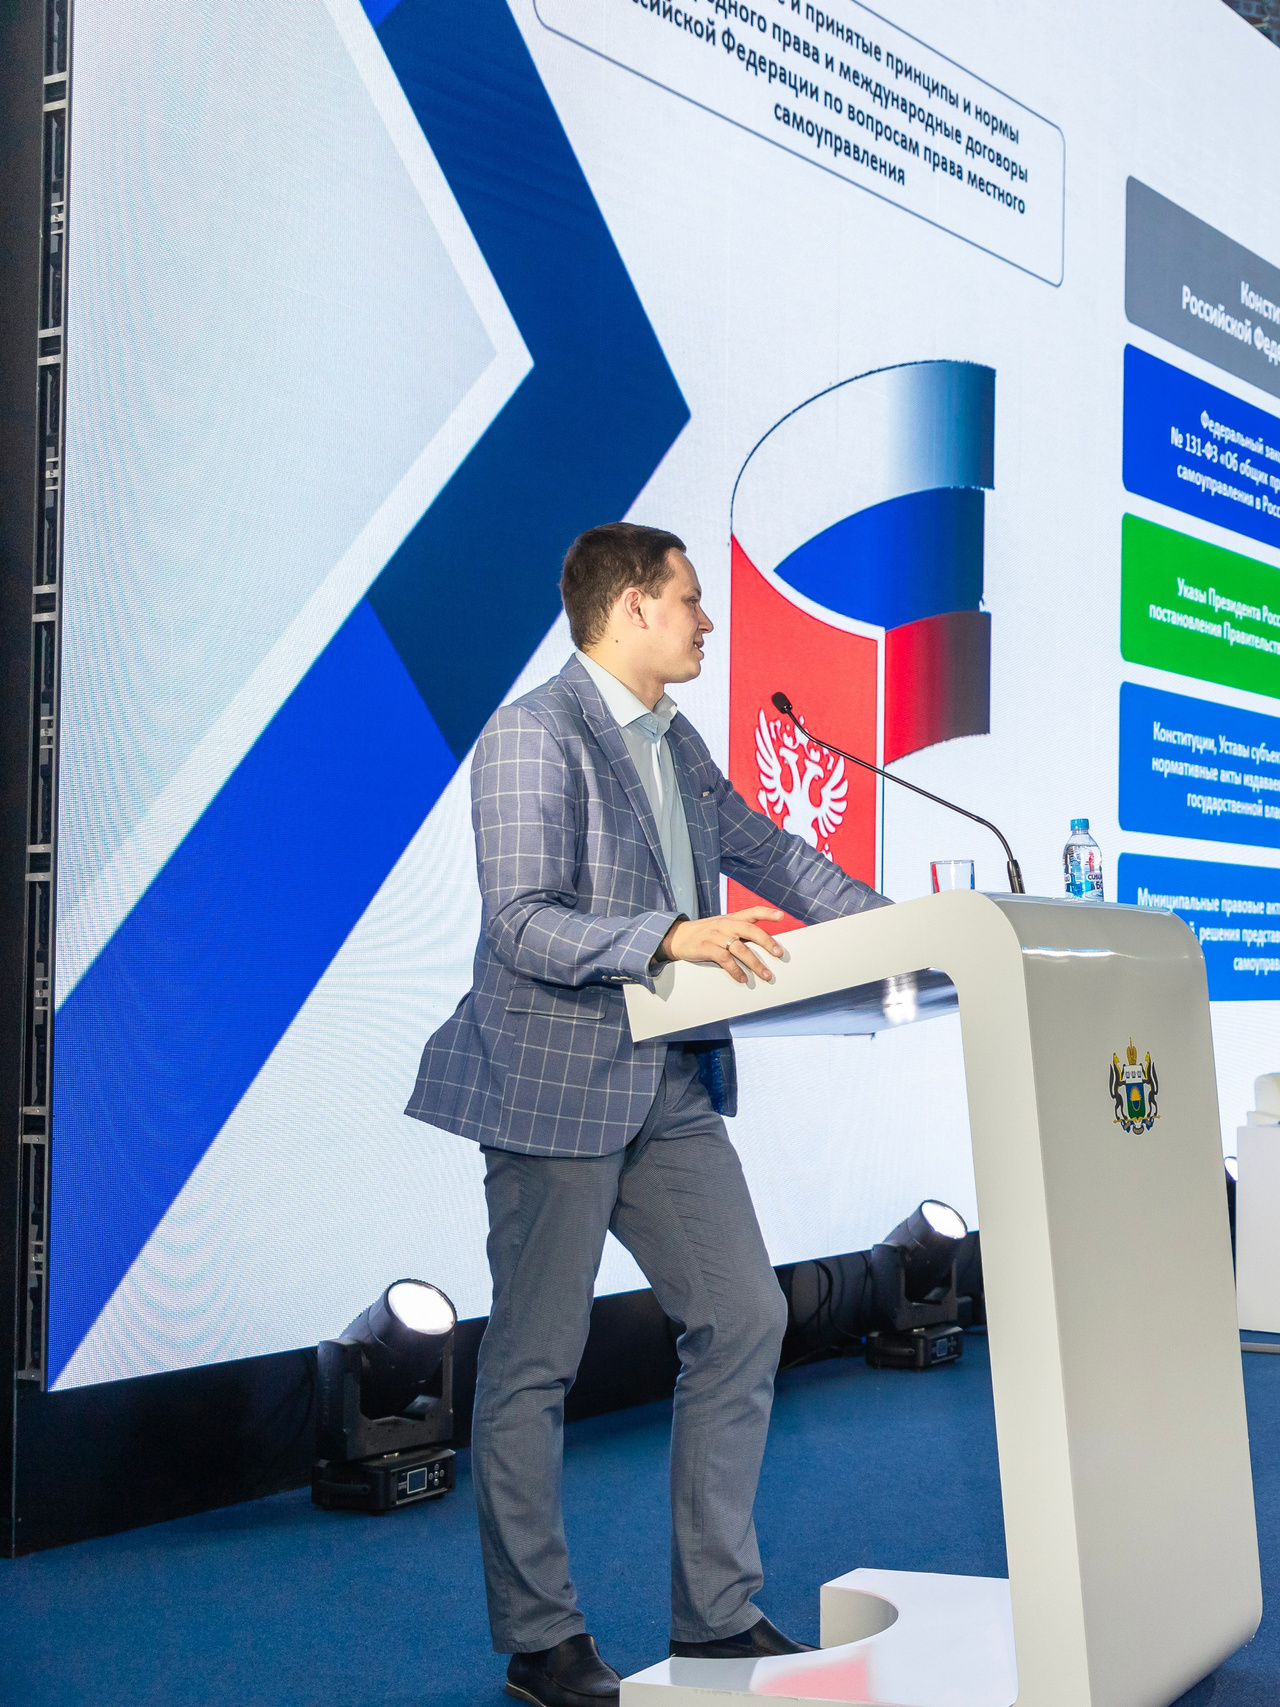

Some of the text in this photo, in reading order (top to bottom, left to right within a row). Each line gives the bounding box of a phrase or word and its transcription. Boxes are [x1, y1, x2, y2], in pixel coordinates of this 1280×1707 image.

[806, 3, 882, 62] принятые
[886, 51, 959, 109] принципы
[963, 96, 971, 116] и
[975, 104, 1019, 144] нормы
[721, 27, 819, 102] Федерации
[824, 90, 843, 114] по
[848, 103, 919, 157] вопросам
[924, 146, 963, 181] права
[967, 170, 1026, 215] местного
[772, 22, 820, 64] права
[825, 52, 834, 73] и
[839, 61, 962, 145] международные
[966, 135, 1028, 183] договоры
[774, 102, 905, 187] самоуправления
[1182, 284, 1252, 346] Российской
[1200, 410, 1264, 454] Федеральный
[1170, 426, 1184, 449] №
[1185, 432, 1219, 464] 131-ФЗ
[1220, 450, 1239, 472] «Об
[1239, 458, 1269, 486] общих
[1177, 463, 1254, 508] самоуправления
[1255, 496, 1262, 511] в
[1149, 603, 1222, 639] постановления
[1177, 576, 1207, 604] Указы
[1208, 587, 1261, 621] Президента
[1153, 721, 1217, 755] Конституции,
[1218, 734, 1250, 759] Уставы
[1151, 756, 1218, 781] нормативные
[1220, 769, 1242, 786] акты
[1187, 792, 1263, 817] государственной
[1137, 886, 1220, 913] Муниципальные
[1221, 898, 1264, 917] правовые
[1199, 926, 1240, 946] решения
